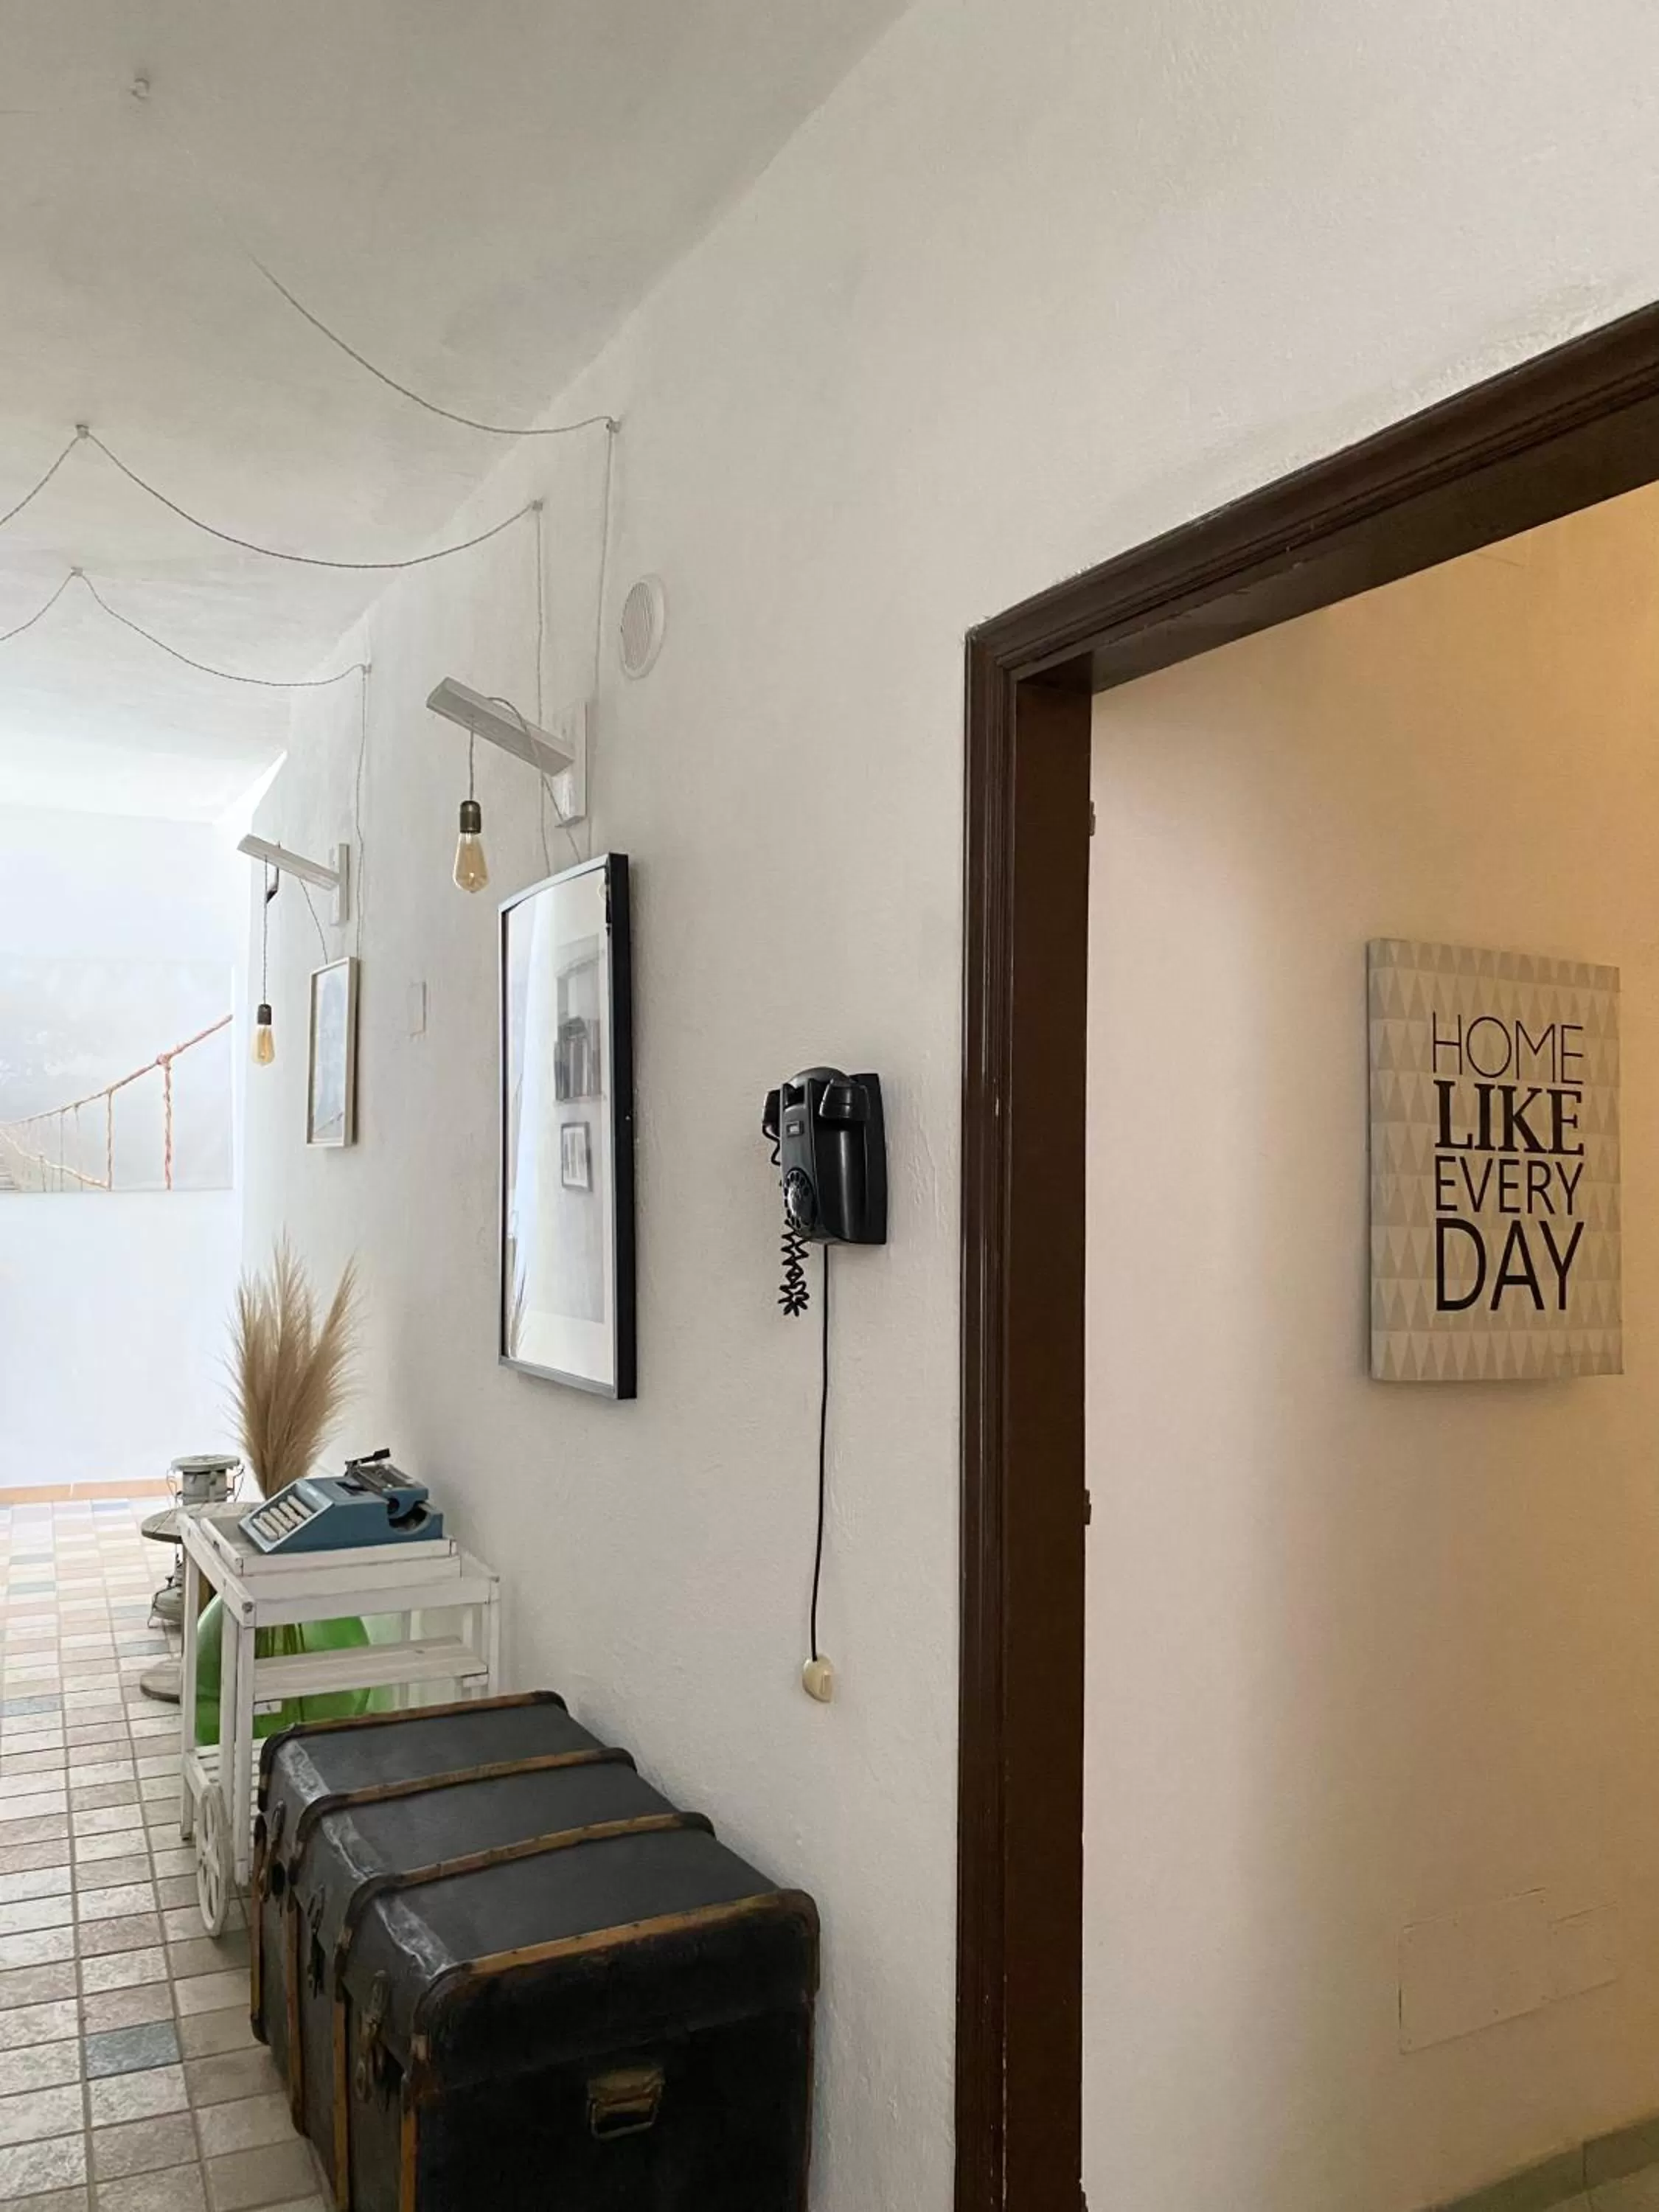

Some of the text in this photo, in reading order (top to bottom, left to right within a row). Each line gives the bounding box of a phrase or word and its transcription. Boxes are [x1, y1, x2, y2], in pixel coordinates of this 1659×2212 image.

[1433, 1012, 1583, 1084] HOME
[1433, 1080, 1584, 1155] LIKE
[1435, 1155, 1583, 1215] EVERY
[1436, 1218, 1585, 1310] DAY
